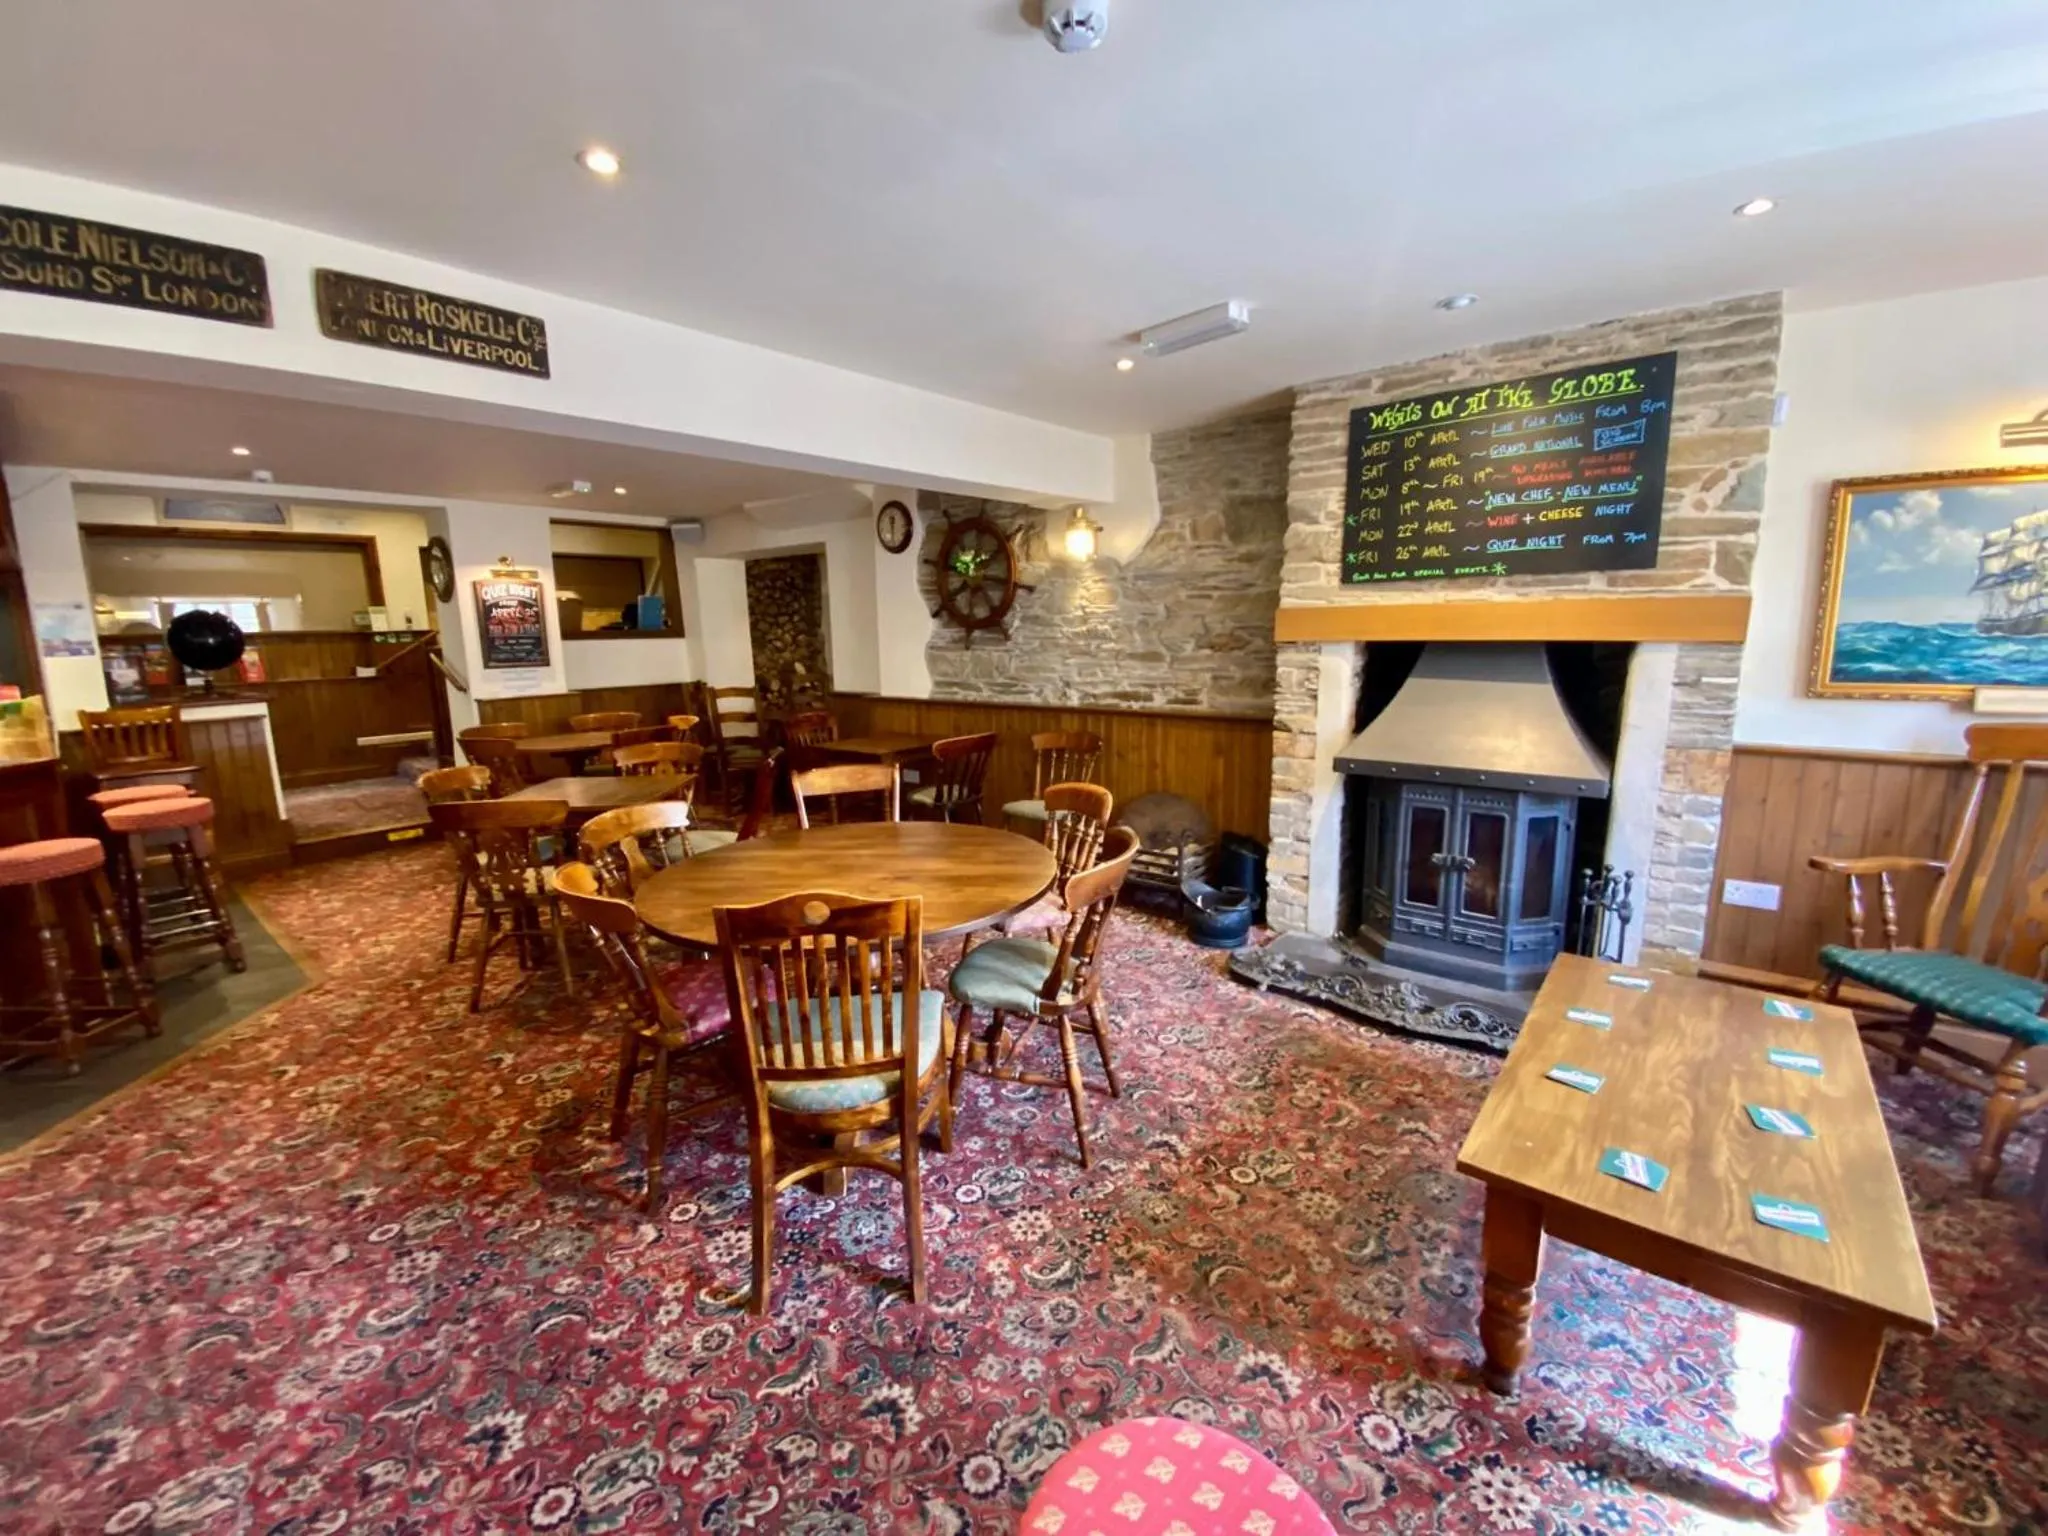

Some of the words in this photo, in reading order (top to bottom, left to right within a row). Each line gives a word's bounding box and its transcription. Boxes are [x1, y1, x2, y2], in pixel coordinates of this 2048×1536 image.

[1, 252, 85, 290] SOHO
[141, 267, 263, 319] LONDON
[413, 292, 511, 343] ROSKELL
[1430, 395, 1460, 419] ON
[1459, 388, 1491, 417] AT
[1493, 380, 1534, 408] THE
[1361, 440, 1392, 459] WED
[1430, 430, 1460, 446] APRIL
[1361, 462, 1387, 481] SAT
[1429, 453, 1461, 469] APRIL
[1360, 508, 1382, 523] FRI
[1426, 499, 1458, 512] APRIL
[1521, 487, 1553, 501] CHEF
[1564, 484, 1593, 499] NEW
[1361, 484, 1389, 500] MON
[1443, 474, 1464, 489] FRI
[1359, 529, 1384, 543] MON
[1424, 521, 1457, 535] APRIL
[1487, 513, 1519, 528] WINE
[1539, 506, 1585, 521] CHEESE
[1594, 503, 1635, 517] NIGHT
[1358, 551, 1379, 566] FRI
[1422, 544, 1451, 559] APRIL
[1486, 537, 1518, 552] QUIZ
[1526, 533, 1566, 548] NIGHT
[1623, 531, 1649, 543] 7pm
